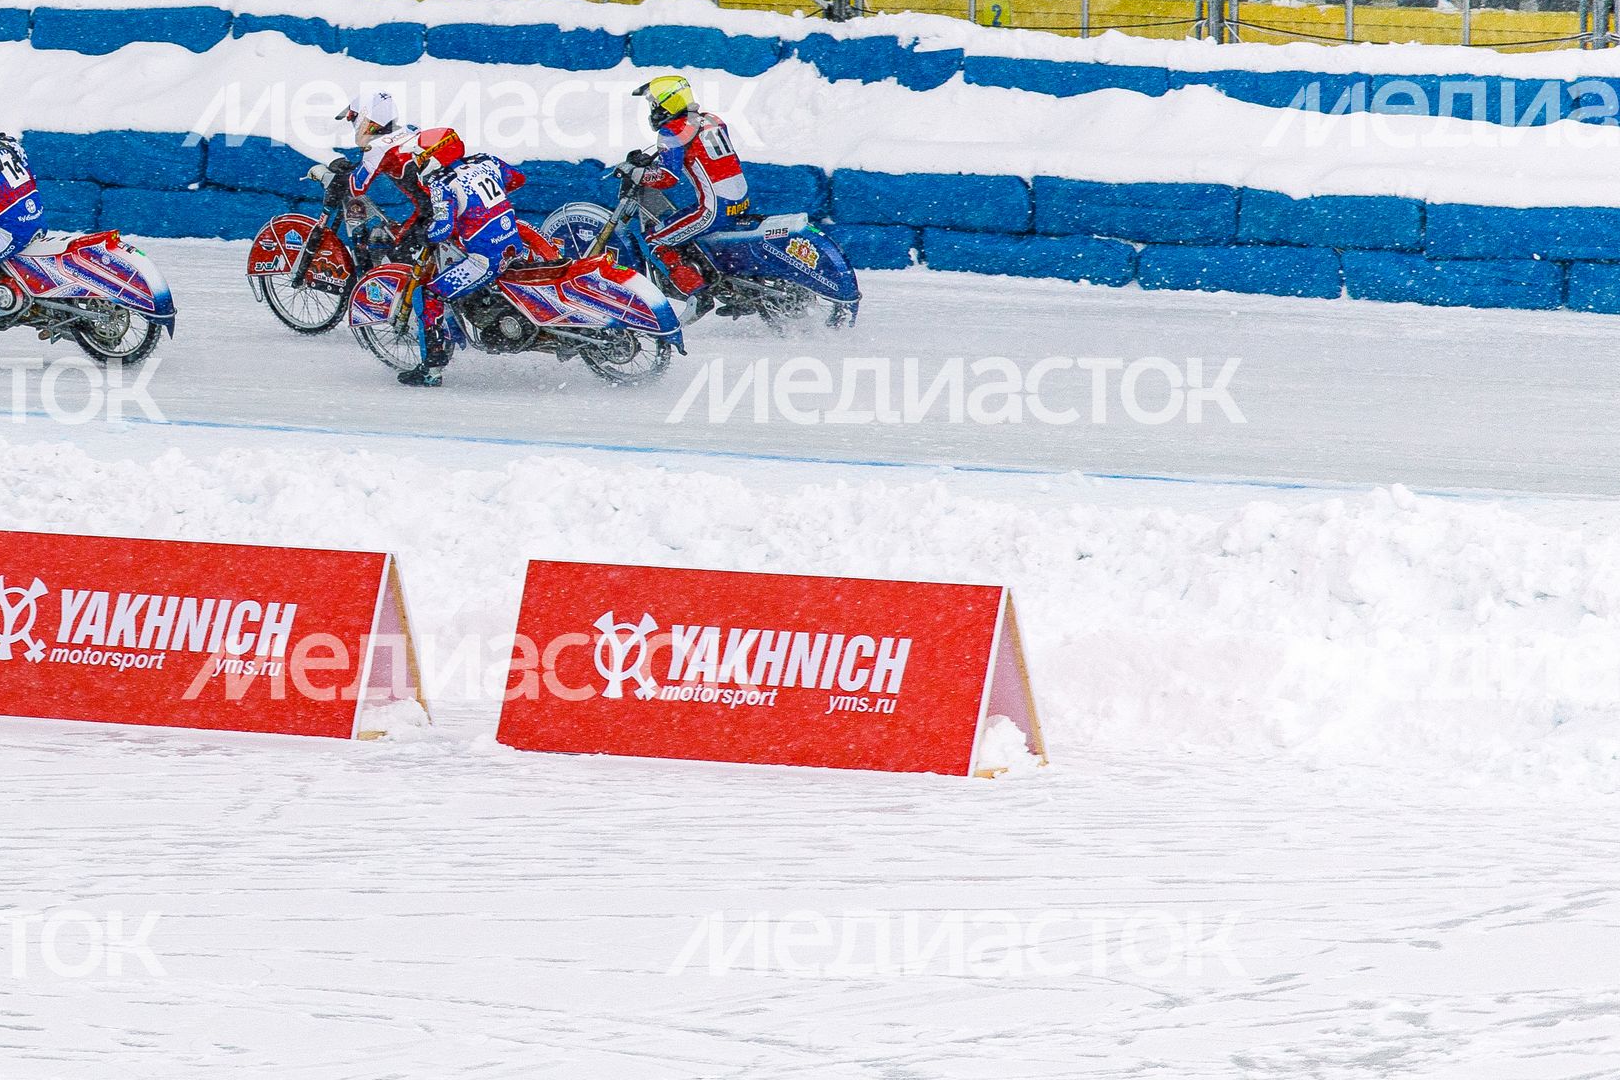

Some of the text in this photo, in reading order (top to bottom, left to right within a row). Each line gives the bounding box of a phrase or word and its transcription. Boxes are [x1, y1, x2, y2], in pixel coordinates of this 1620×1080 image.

[991, 4, 1003, 27] 2
[703, 127, 731, 157] 11
[3, 160, 25, 181] 14
[478, 177, 501, 201] 12
[56, 589, 298, 657] YAKHNICH
[49, 647, 282, 677] motorsport yms.ru
[667, 624, 912, 695] YAKHNICH
[660, 684, 897, 715] motorsport yms.ru
